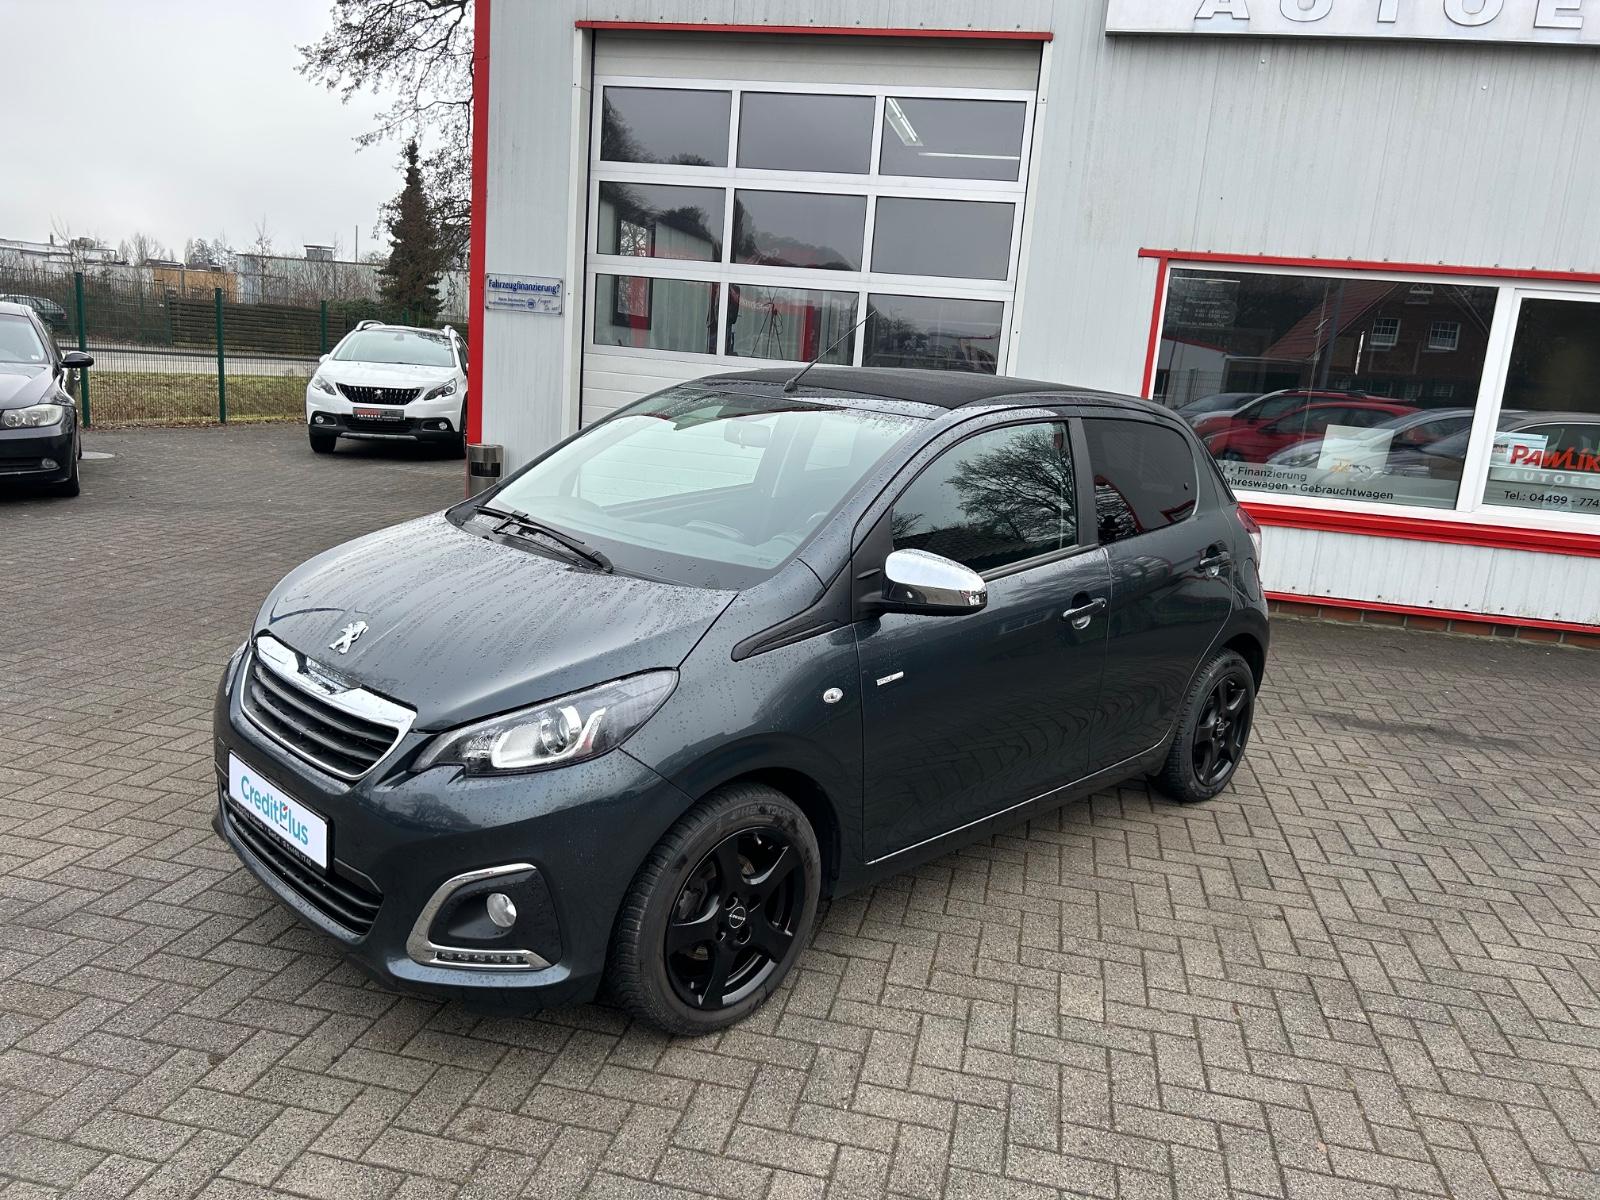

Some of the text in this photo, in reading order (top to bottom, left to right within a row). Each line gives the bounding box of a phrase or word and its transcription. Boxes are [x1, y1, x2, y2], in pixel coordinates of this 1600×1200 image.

[488, 279, 560, 294] Fahrzeugfinanzierung?
[1237, 466, 1307, 482] Finanzierung
[1300, 483, 1394, 500] Gebrauchtwagen
[1504, 490, 1526, 500] Tel.:
[1529, 493, 1568, 505] 04499
[241, 775, 309, 846] CreditPlus
